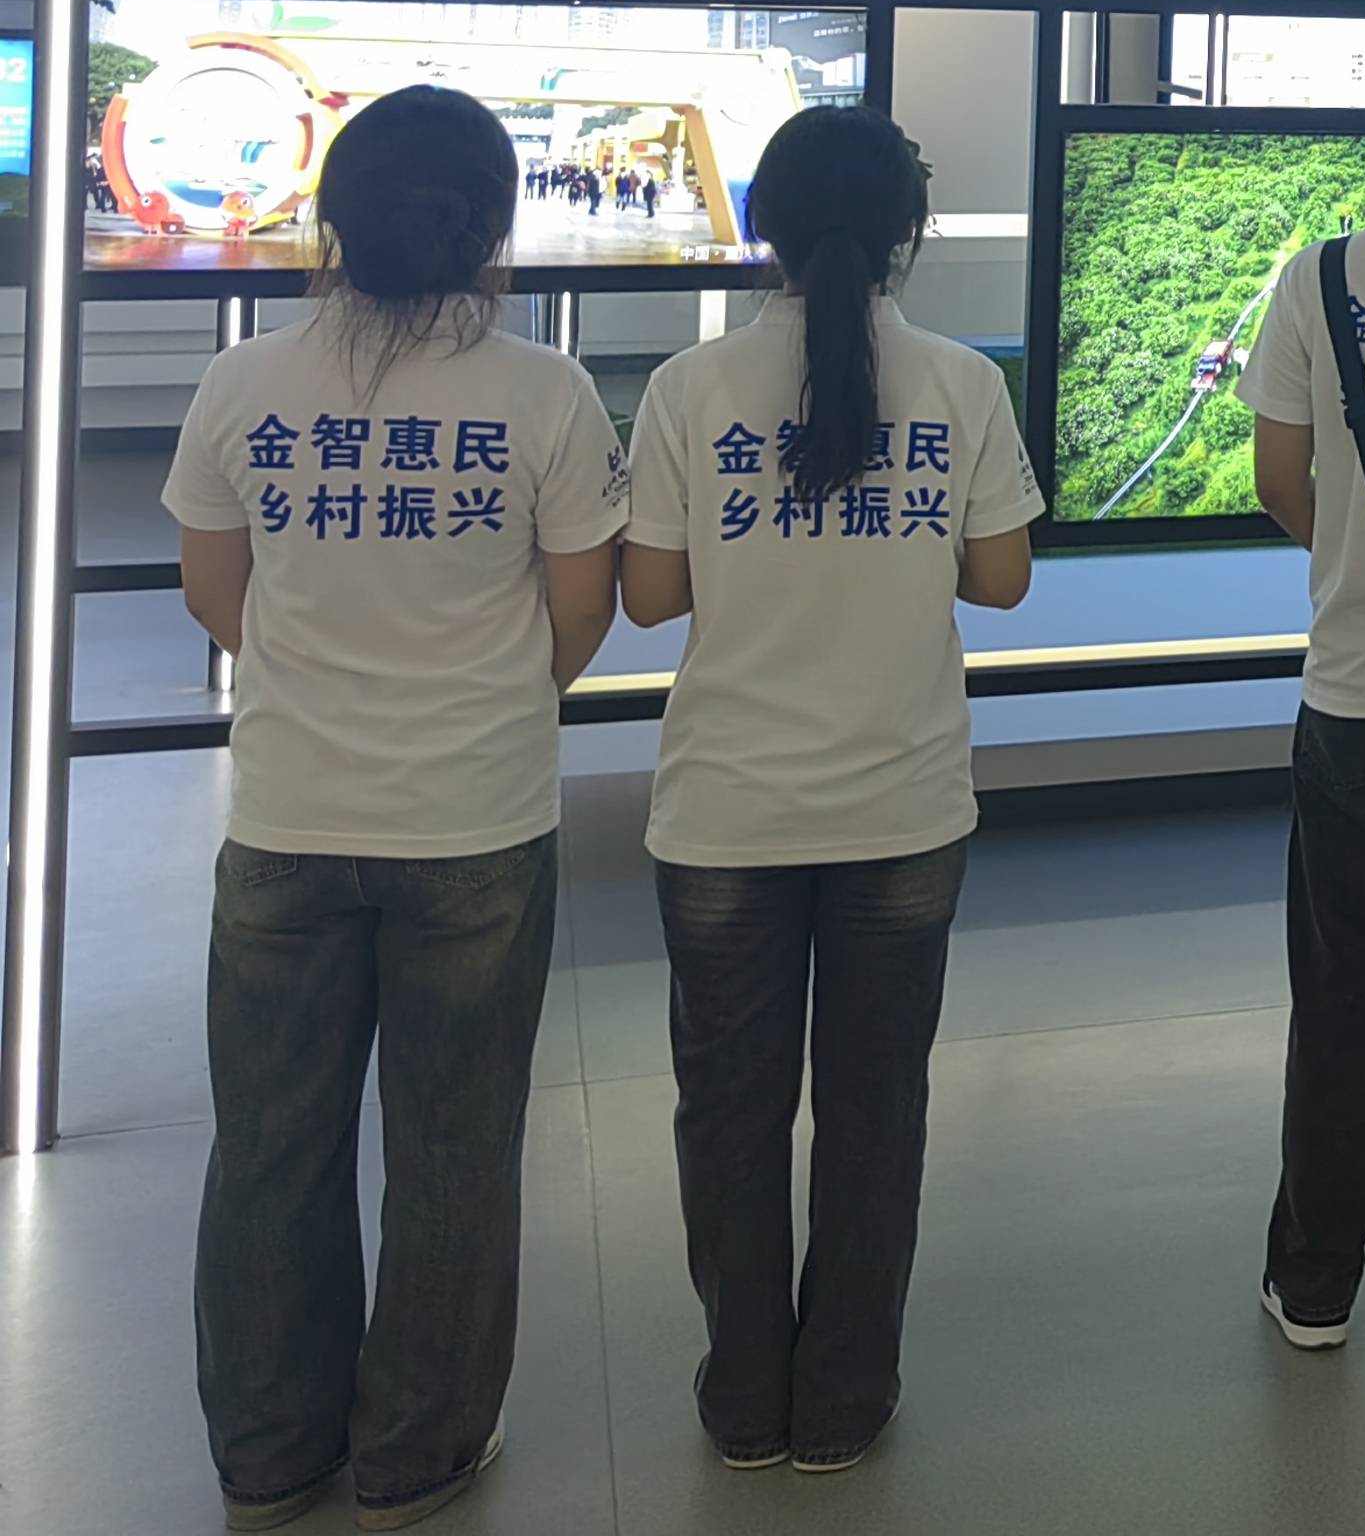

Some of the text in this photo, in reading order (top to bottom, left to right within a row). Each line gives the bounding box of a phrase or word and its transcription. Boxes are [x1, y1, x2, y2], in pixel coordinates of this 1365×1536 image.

[245, 412, 511, 474] 金智惠民
[258, 482, 506, 541] 乡村振兴
[719, 485, 951, 543] 乡村振兴
